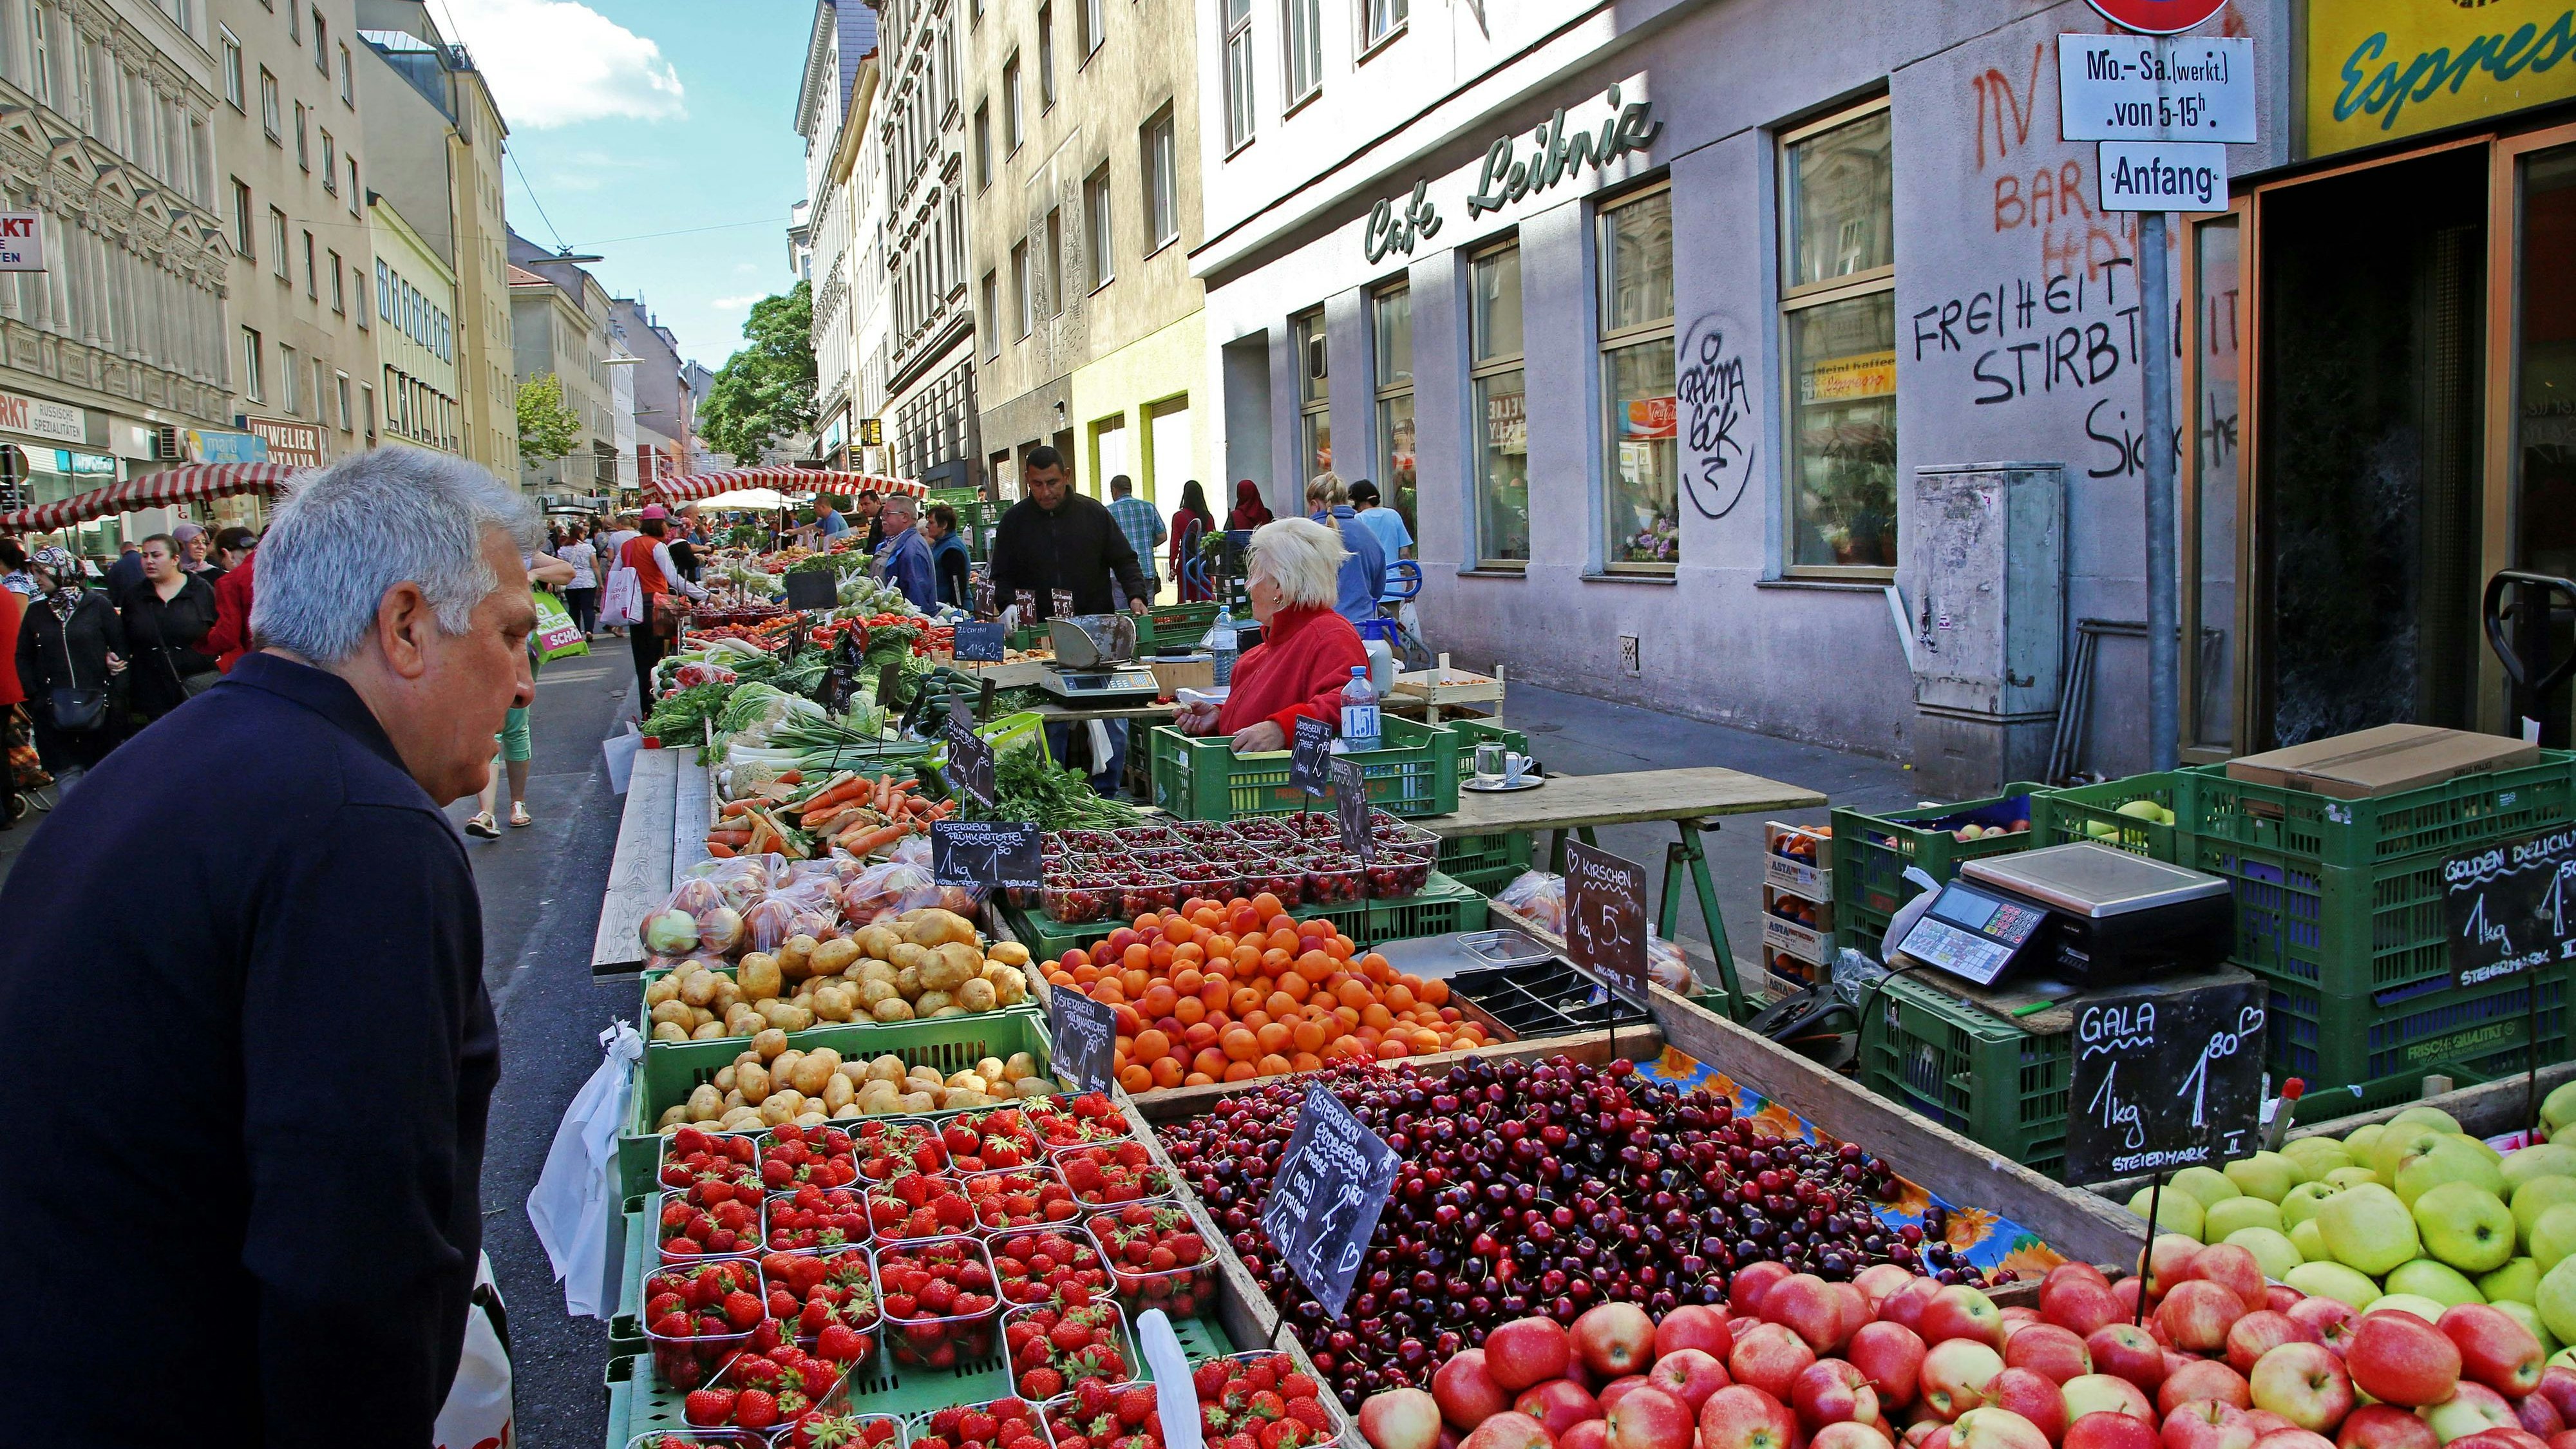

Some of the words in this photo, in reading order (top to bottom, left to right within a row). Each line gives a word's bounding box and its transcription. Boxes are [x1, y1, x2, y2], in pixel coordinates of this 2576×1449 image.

[2333, 10, 2576, 131] Espres
[2114, 102, 2152, 126] von
[1467, 82, 1663, 221] Leibniz
[2114, 156, 2212, 204] Anfang
[0, 218, 34, 238] KT
[0, 252, 21, 263] EN
[1913, 258, 2132, 361] FREIHEIT
[34, 418, 80, 438] SPEZIALITÄTEN
[39, 404, 74, 422] RUSSISCHE
[540, 616, 571, 632] MACH
[949, 718, 978, 748] ZWIEBEL
[949, 742, 968, 782] 2kg
[940, 846, 972, 881] 1kg
[1583, 857, 1631, 889] KIRSCHEN
[2445, 848, 2505, 882] GOLDEN
[2512, 829, 2576, 864] DELICIU
[1571, 892, 1595, 954] 1kg
[2463, 893, 2512, 956] 1kg
[2079, 1002, 2155, 1042] GALA
[1054, 1027, 1071, 1072] 1kg
[2087, 1061, 2145, 1149] 1kg
[1304, 1145, 1329, 1179] TASSE
[1314, 1121, 1370, 1180] ERDBEEREN
[2112, 1146, 2210, 1172] STEIERMARK
